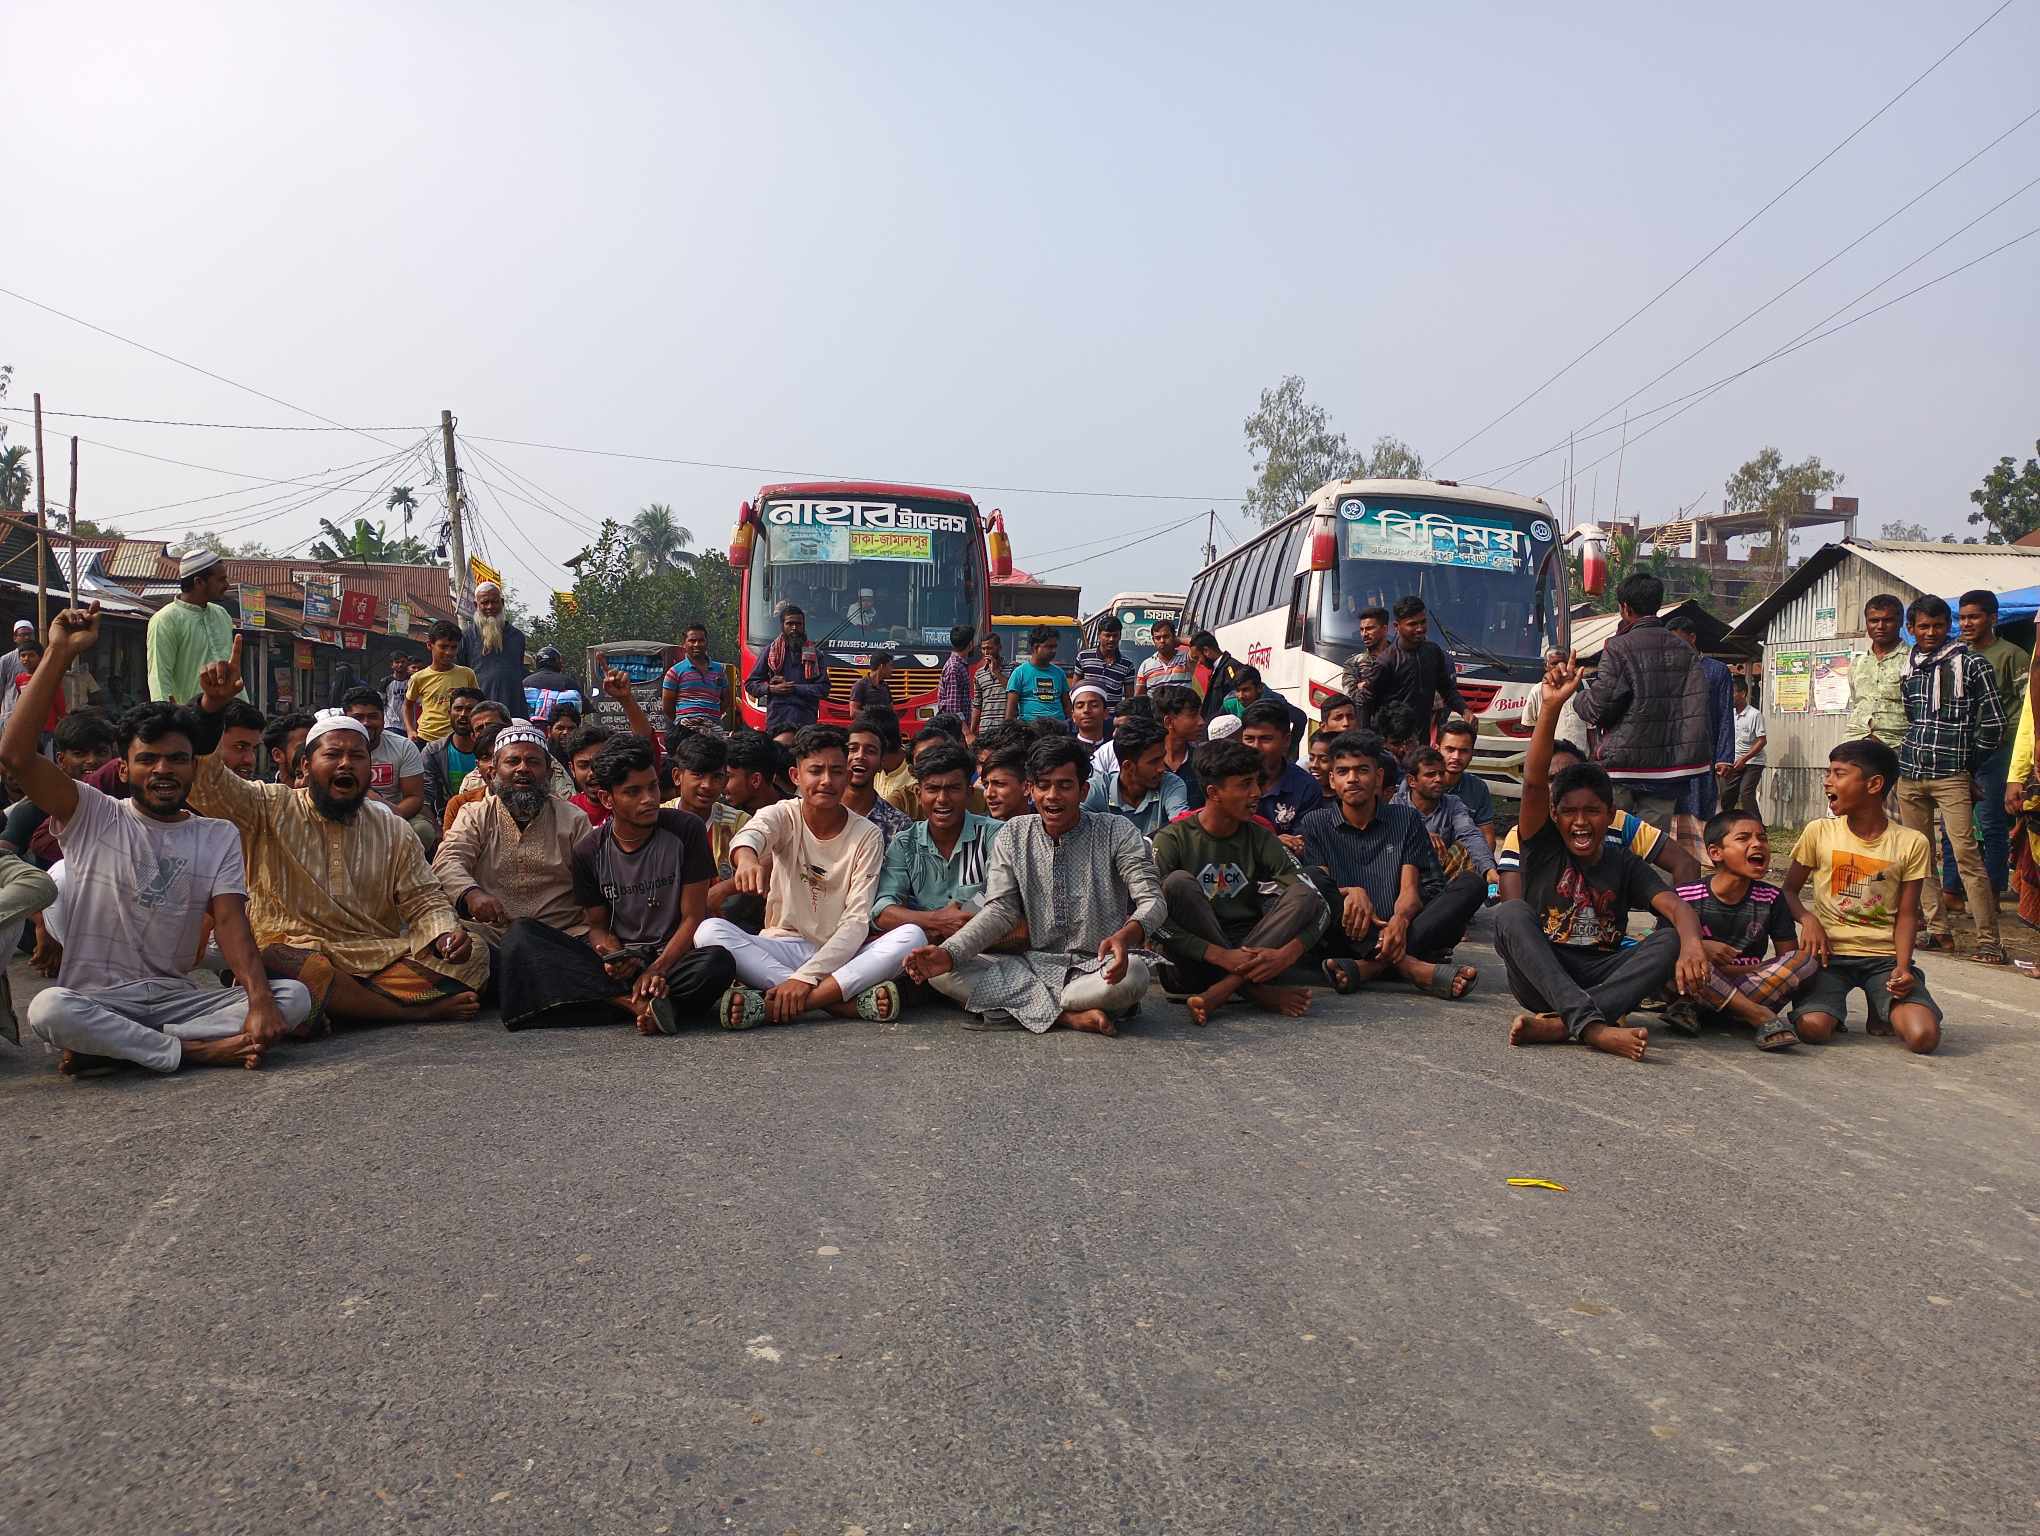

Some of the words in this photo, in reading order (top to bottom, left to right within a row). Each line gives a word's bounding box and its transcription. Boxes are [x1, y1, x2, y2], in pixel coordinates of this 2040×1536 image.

[768, 500, 896, 528] নাহার
[897, 508, 967, 533] ট্রাভেলস
[1372, 509, 1526, 552] বিনিময়
[850, 531, 928, 549] ঢাকা-জামালপুর
[1495, 697, 1527, 711] Bini
[1203, 870, 1240, 885] BLACK
